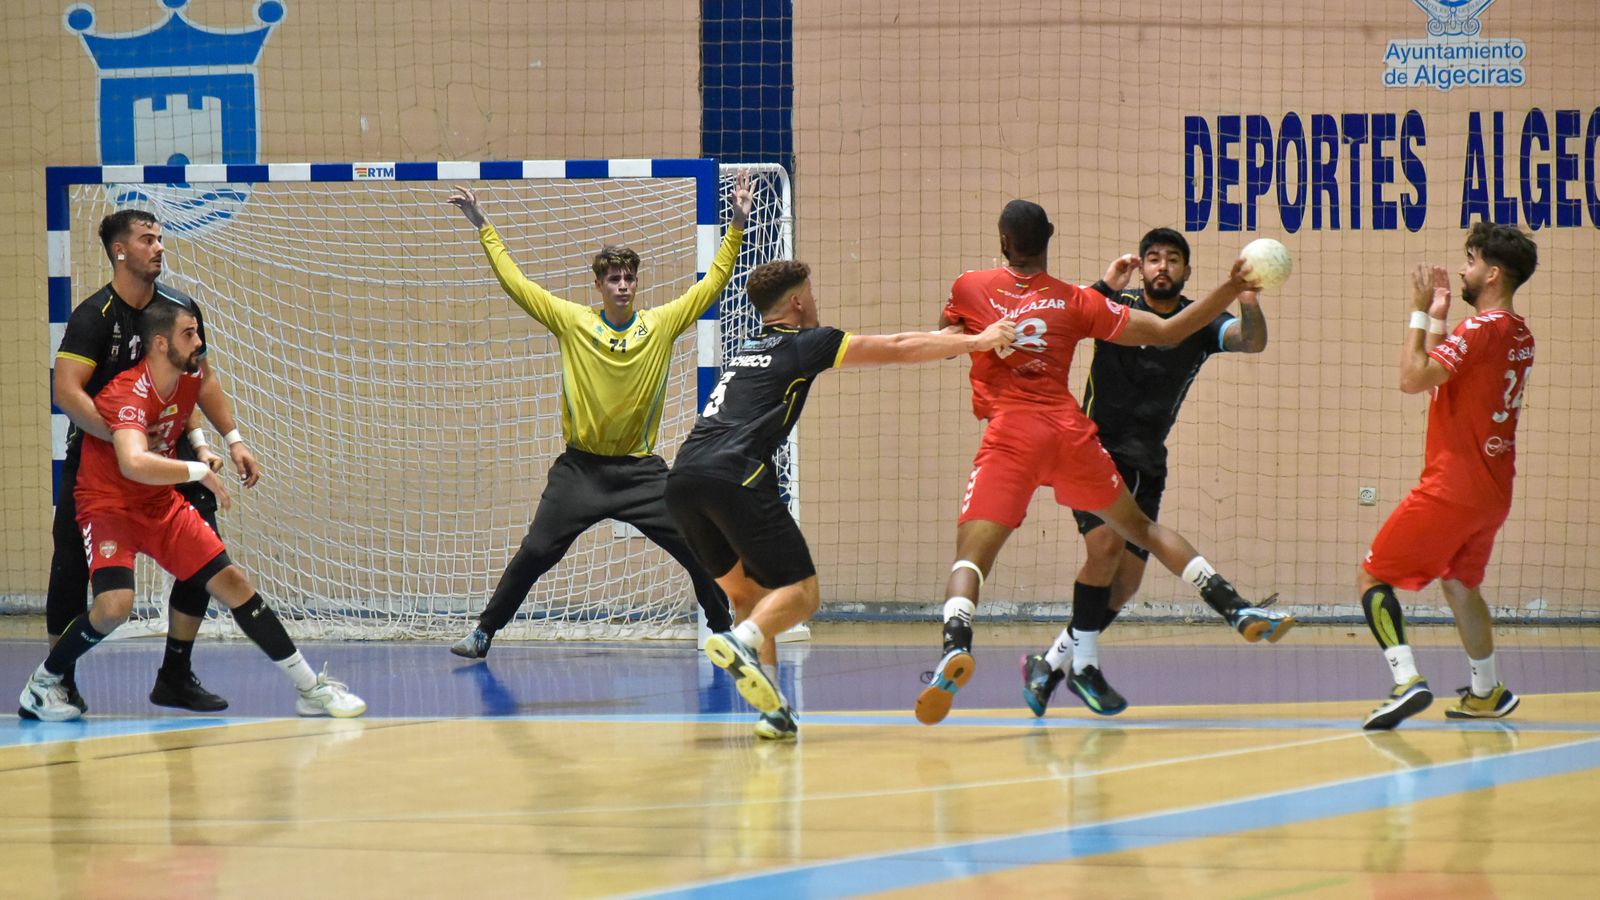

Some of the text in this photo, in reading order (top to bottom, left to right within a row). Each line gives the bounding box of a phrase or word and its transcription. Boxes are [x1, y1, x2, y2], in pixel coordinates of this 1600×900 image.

[1386, 42, 1524, 64] Ayuntamiento
[1384, 64, 1523, 89] de Algeciras
[367, 167, 394, 178] RTM
[1184, 109, 1427, 234] DEPORTES
